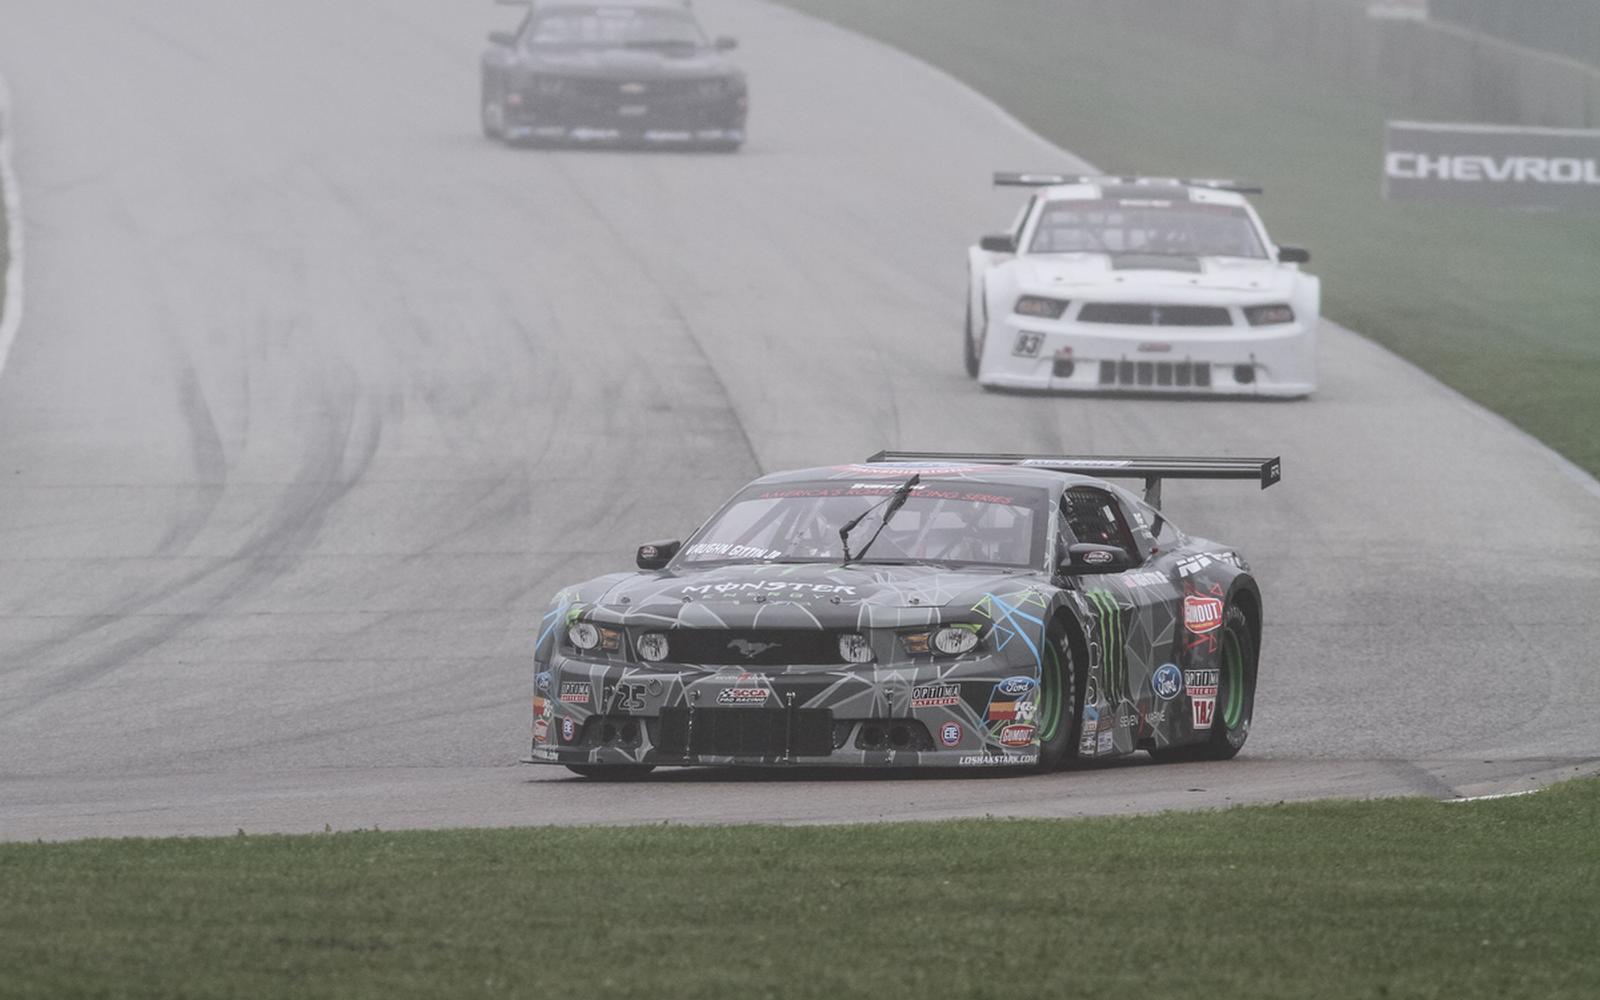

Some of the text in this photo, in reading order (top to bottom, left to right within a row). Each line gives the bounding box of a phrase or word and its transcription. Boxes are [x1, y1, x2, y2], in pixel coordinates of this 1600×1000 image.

[1385, 152, 1600, 184] CHEVROL
[905, 488, 960, 499] ACING
[1006, 680, 1029, 692] Ford
[1158, 669, 1178, 696] Ford
[616, 683, 647, 711] 25
[734, 689, 767, 697] SCCA
[913, 686, 960, 699] OPTIMA
[911, 698, 960, 707] BATTERIES
[1194, 701, 1214, 724] TA2
